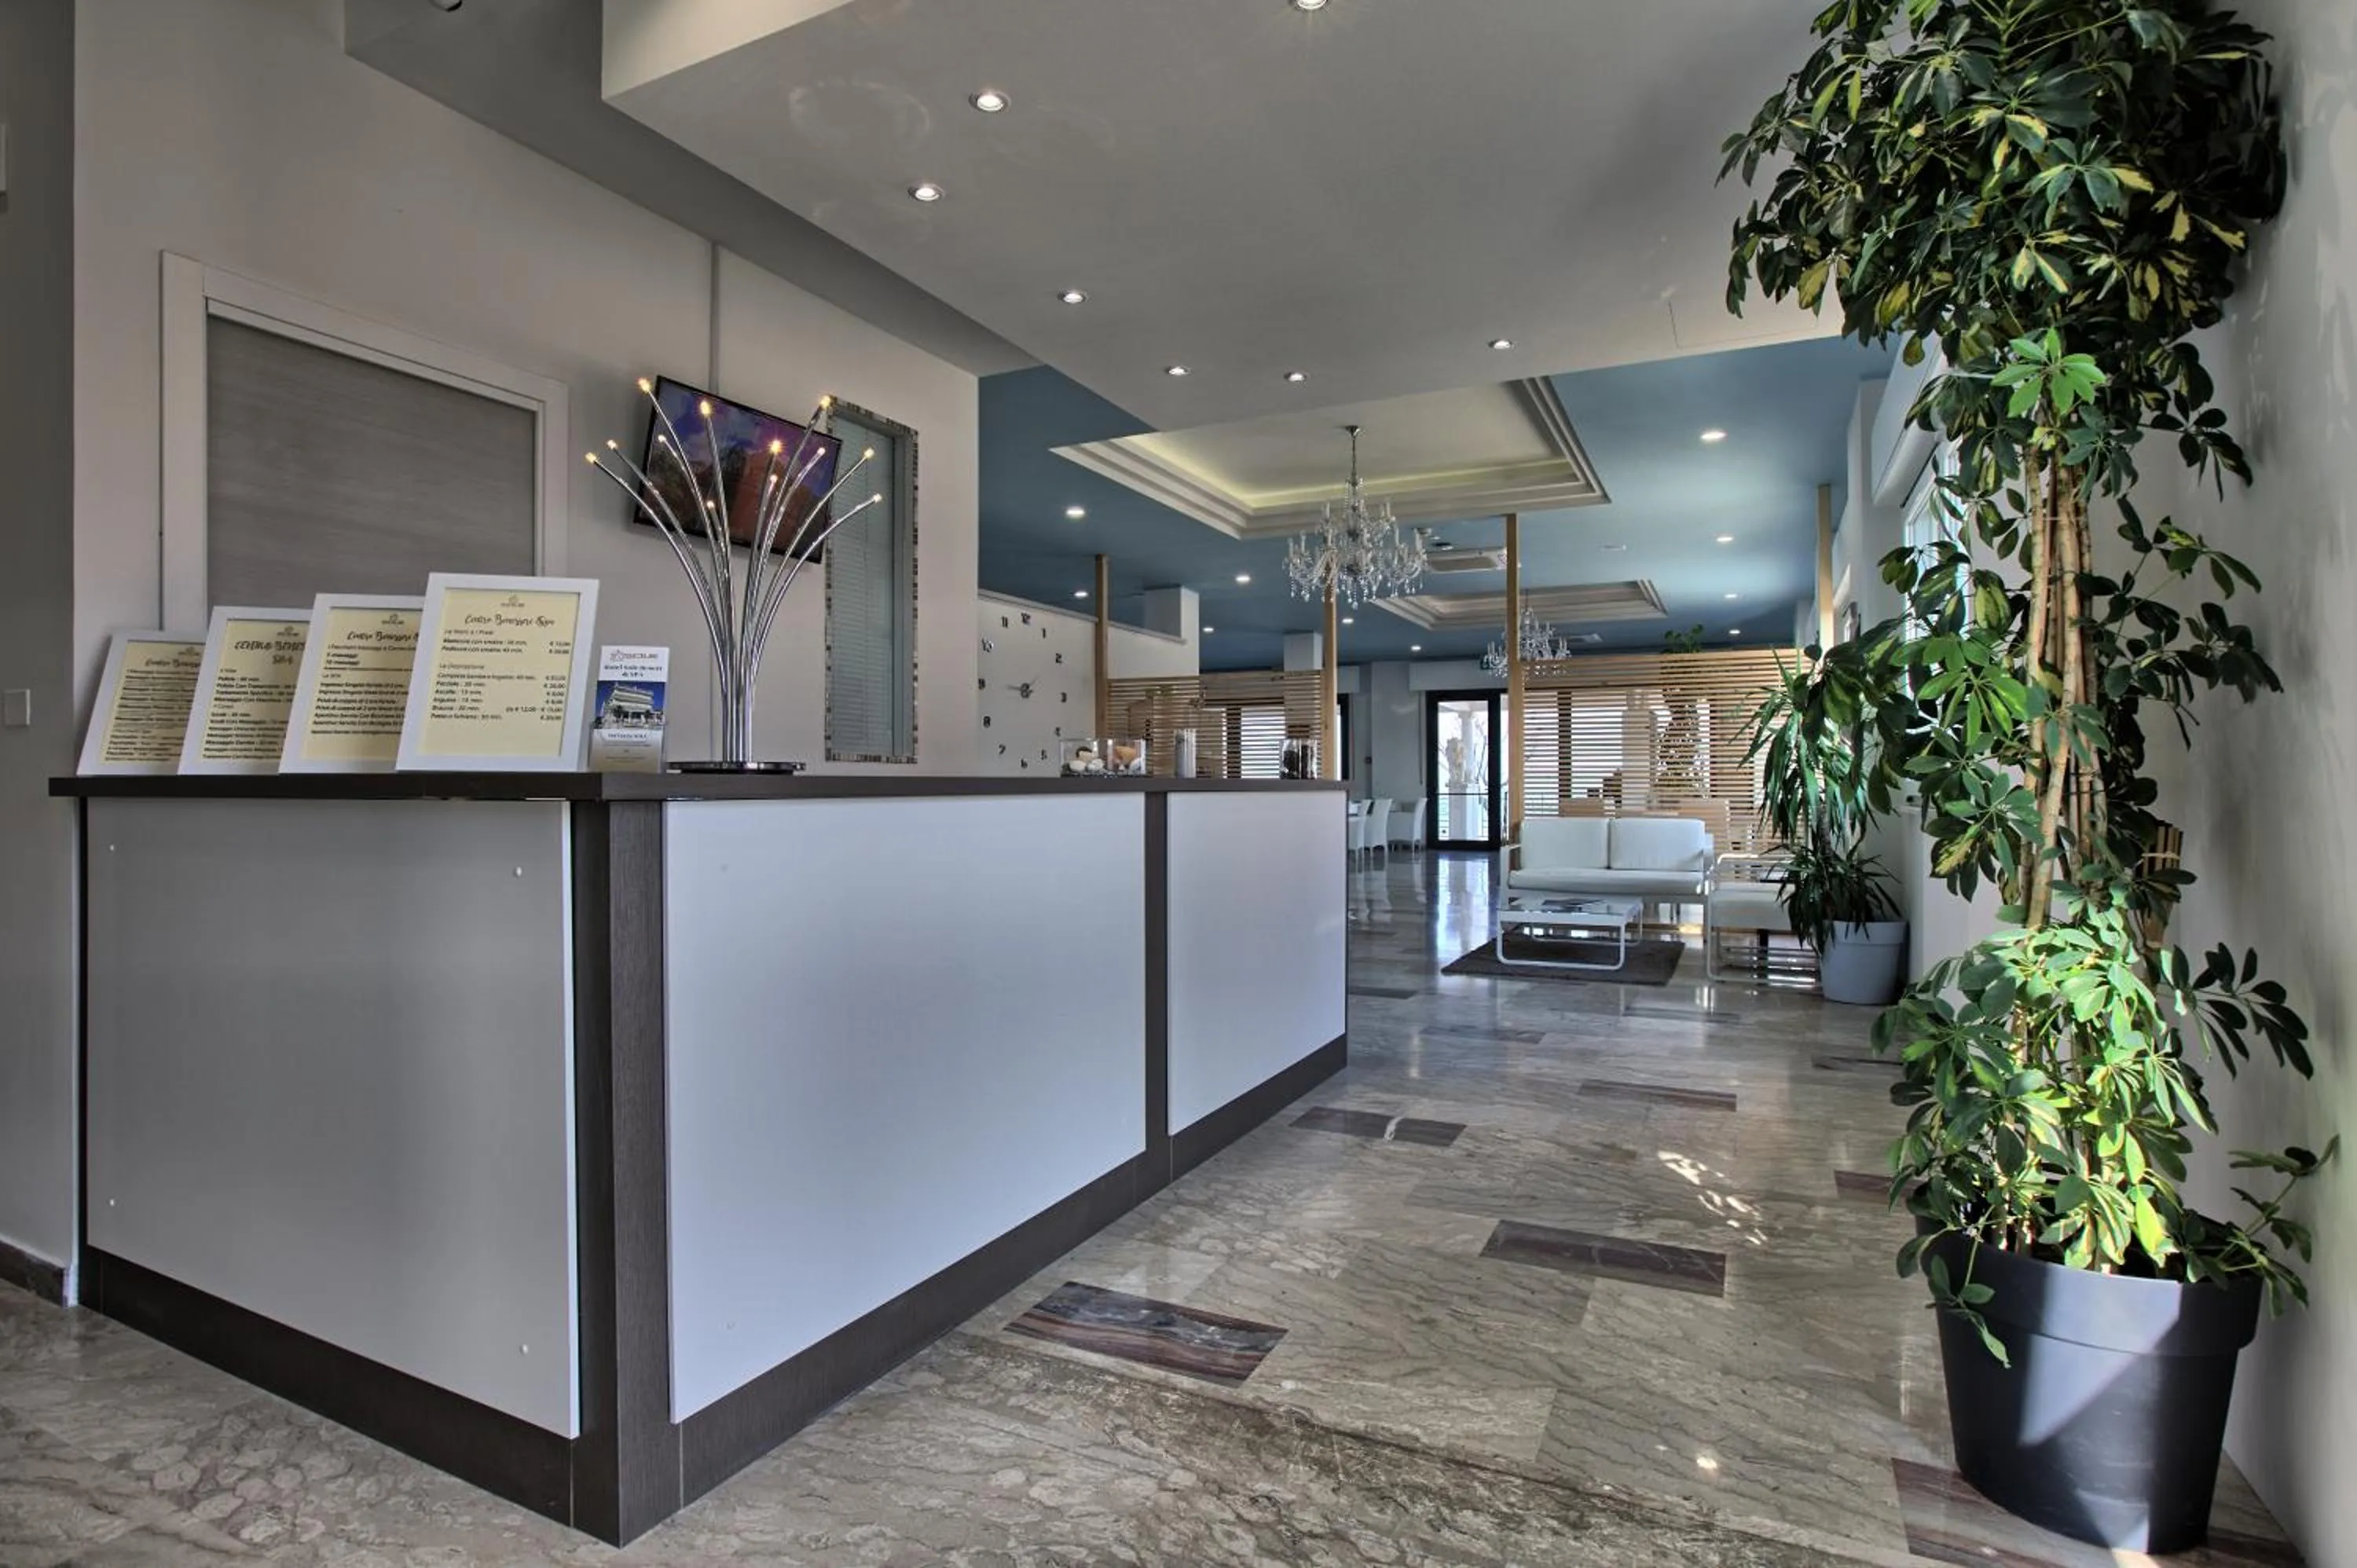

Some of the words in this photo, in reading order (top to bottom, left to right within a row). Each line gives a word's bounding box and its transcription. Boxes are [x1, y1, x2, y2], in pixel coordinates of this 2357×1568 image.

[1002, 616, 1008, 628] 11
[1042, 628, 1046, 639] 1
[1055, 653, 1062, 664] 2
[1061, 692, 1067, 703] 3
[983, 716, 991, 728] 8
[999, 743, 1006, 755] 7
[1021, 758, 1028, 769] 6
